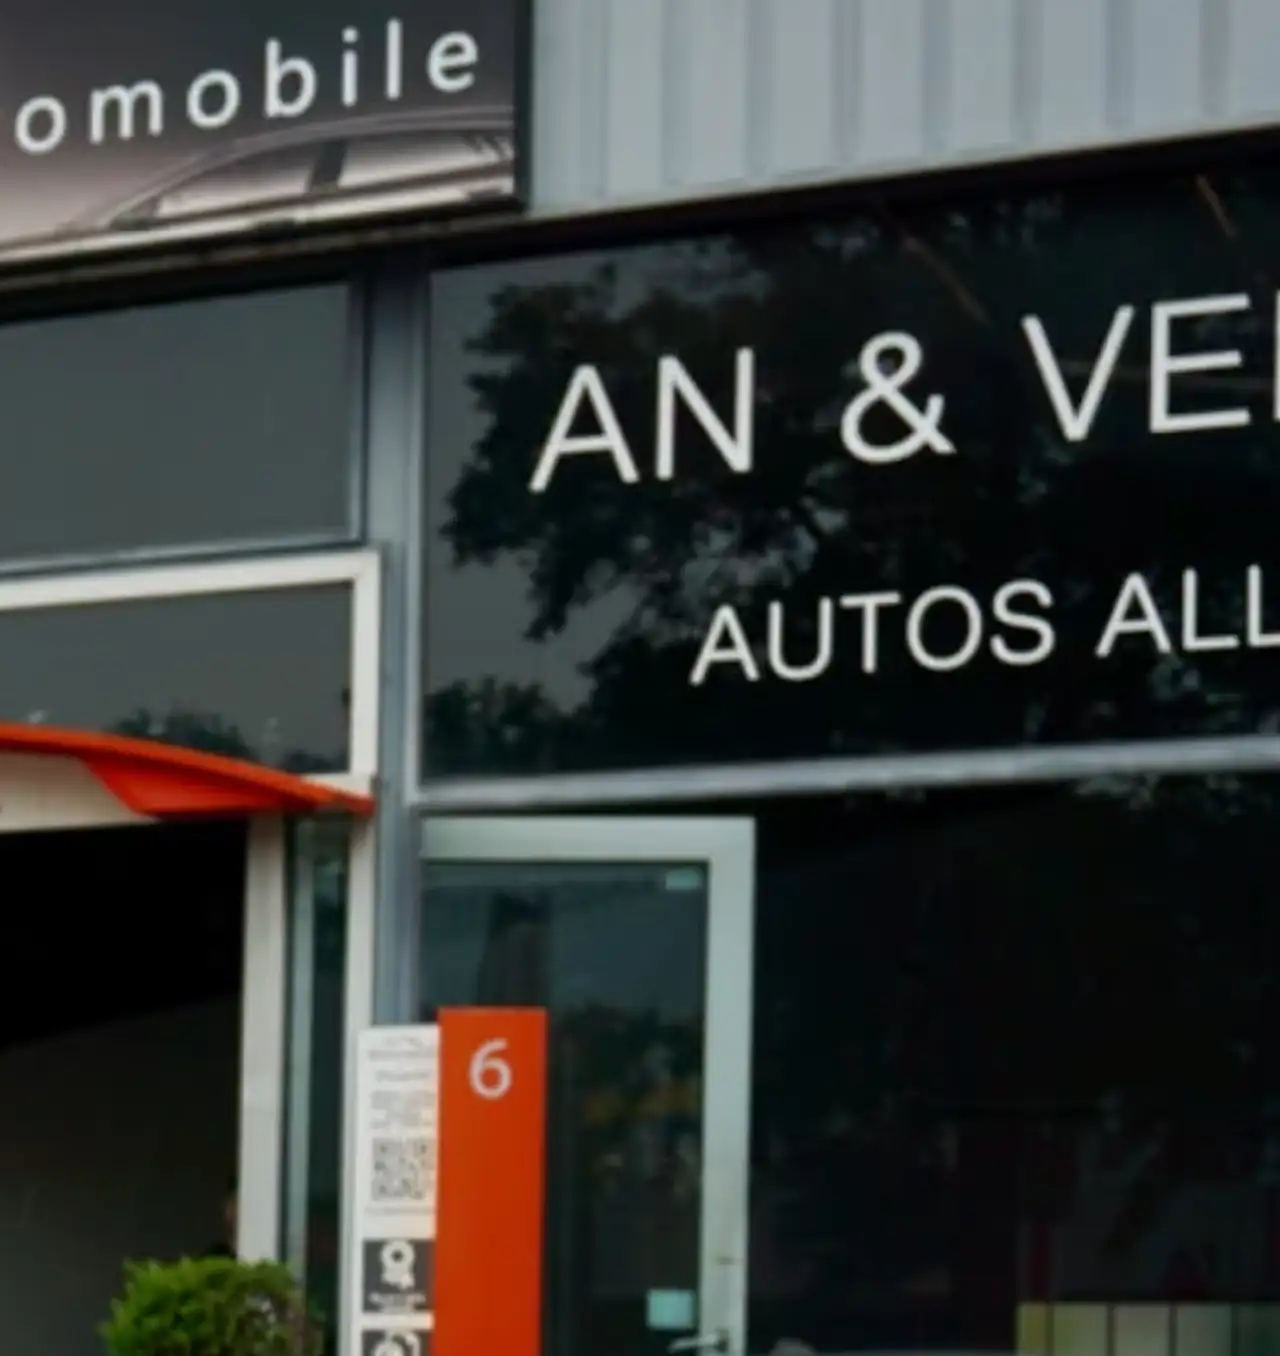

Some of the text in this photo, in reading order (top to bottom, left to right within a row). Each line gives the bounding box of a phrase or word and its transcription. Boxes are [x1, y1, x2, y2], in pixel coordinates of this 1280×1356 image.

[529, 290, 1280, 493] AN & VE
[689, 578, 1056, 687] AUTOS
[468, 1038, 513, 1099] 6
